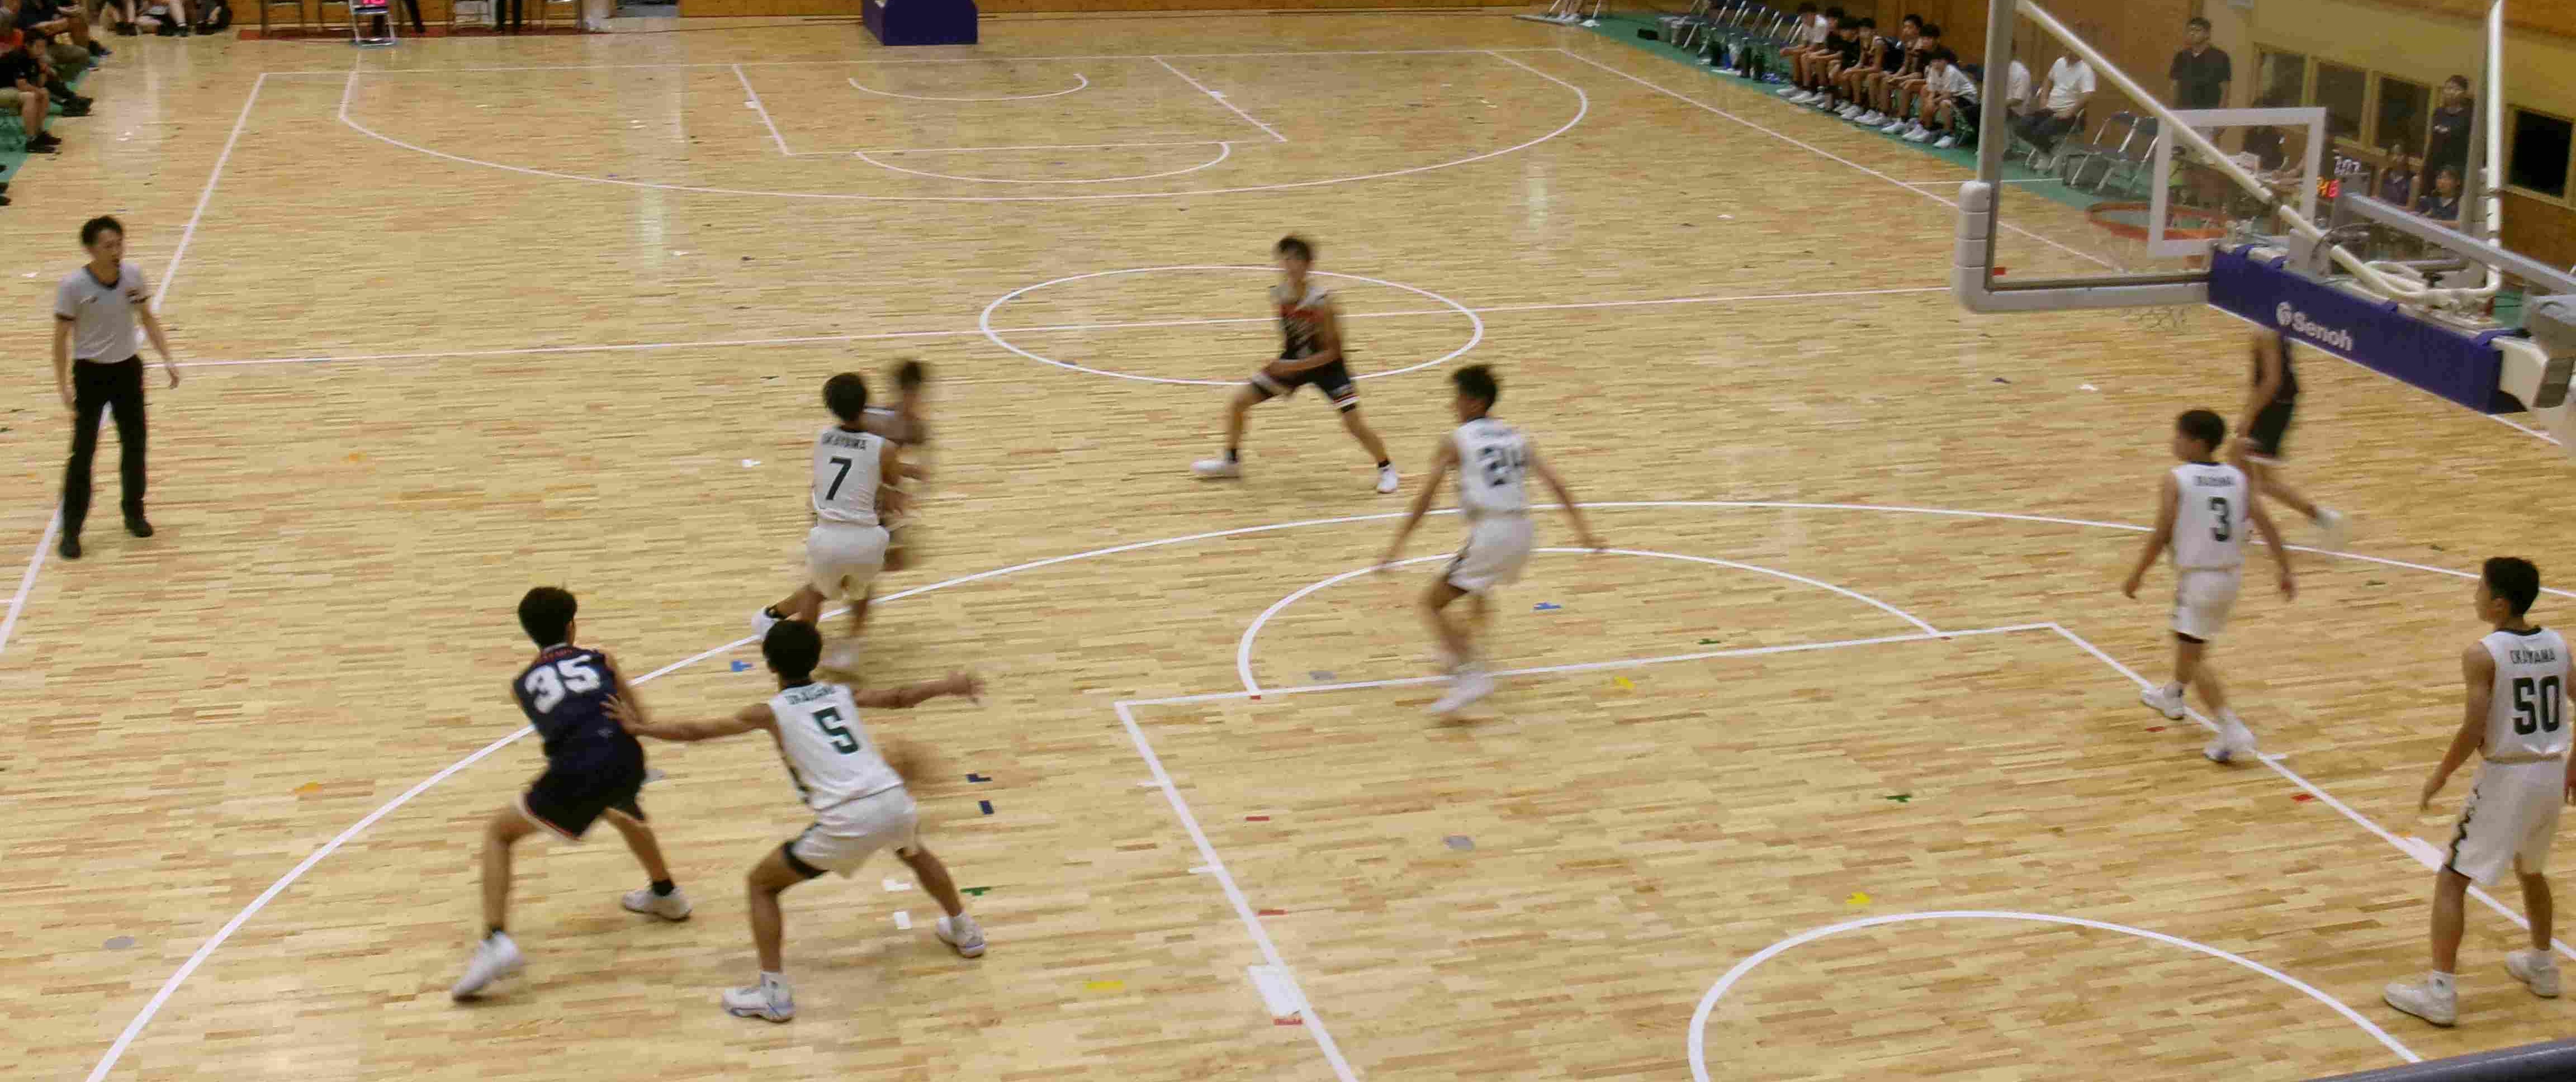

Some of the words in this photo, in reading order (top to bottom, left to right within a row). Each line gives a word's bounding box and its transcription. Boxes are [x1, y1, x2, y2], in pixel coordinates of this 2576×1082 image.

[2291, 311, 2352, 351] Senoh
[826, 456, 853, 501] 7
[2209, 497, 2230, 542] 3
[524, 654, 601, 714] 35
[2513, 675, 2560, 735] 50
[812, 706, 860, 755] 5
